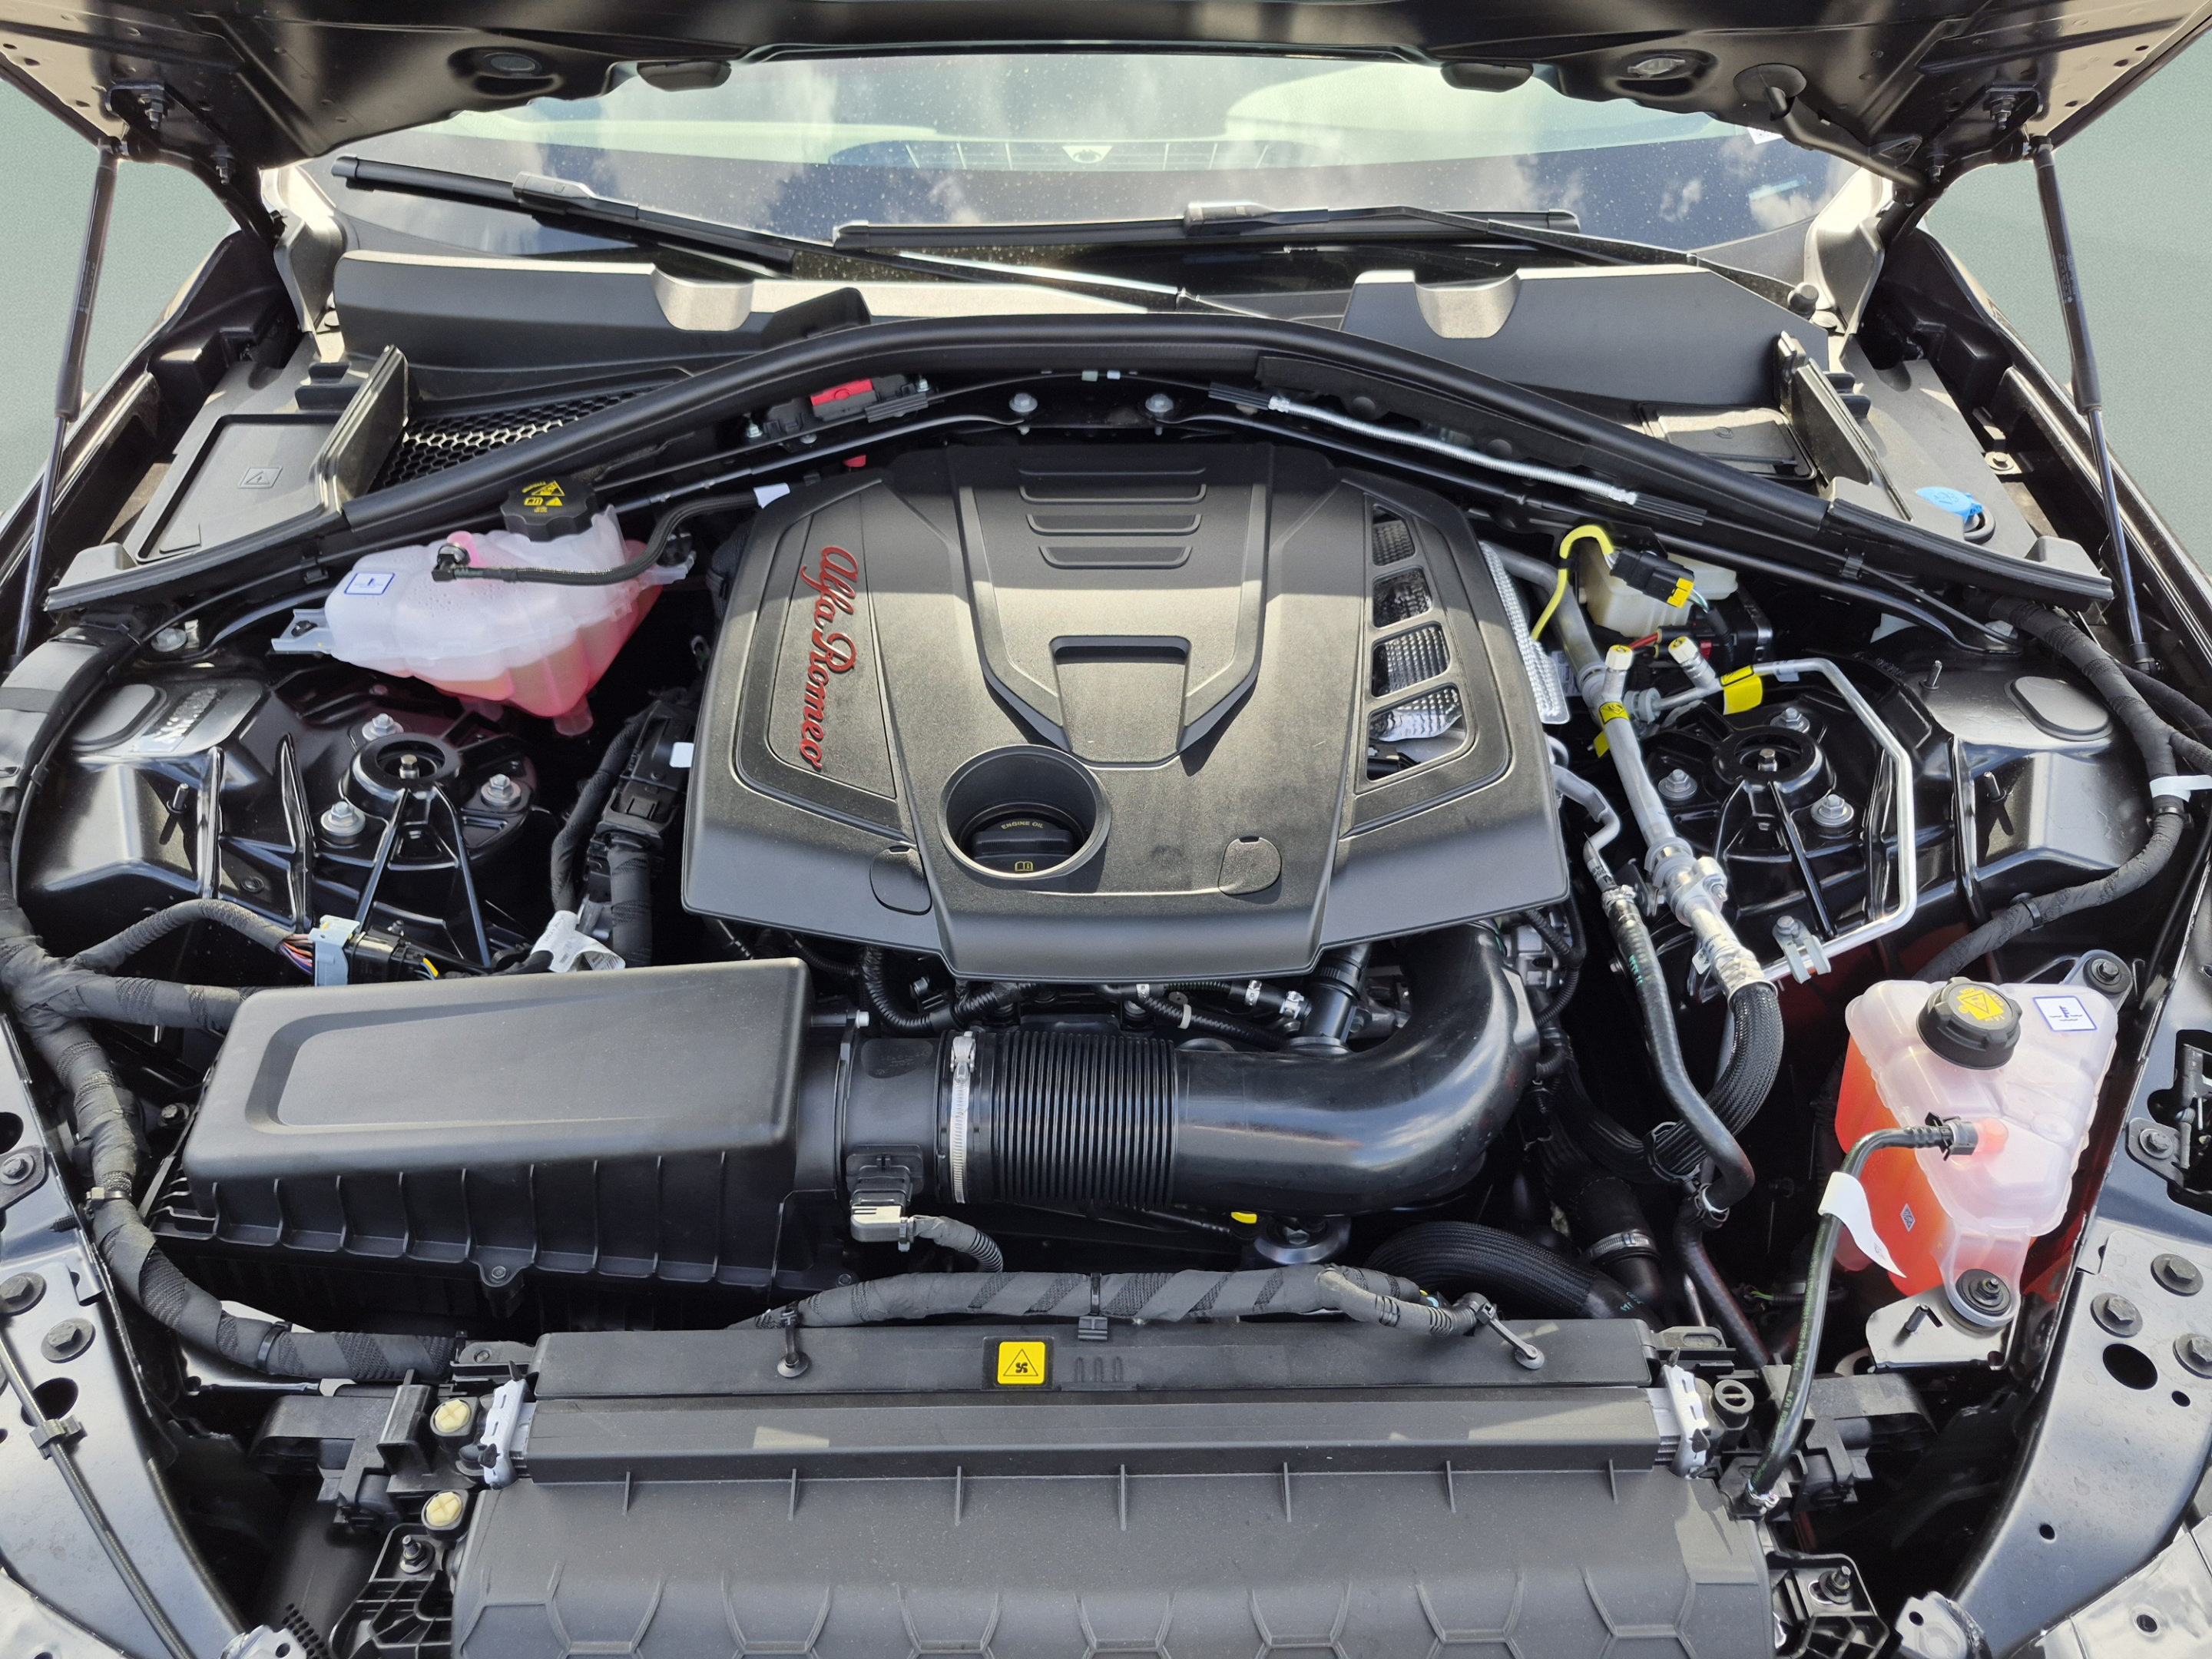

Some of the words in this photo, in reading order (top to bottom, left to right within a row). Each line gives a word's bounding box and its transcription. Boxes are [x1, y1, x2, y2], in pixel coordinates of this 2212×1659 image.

[800, 546, 858, 628] Alfa
[800, 628, 856, 770] Romeo
[1001, 821, 1030, 830] ENGINE
